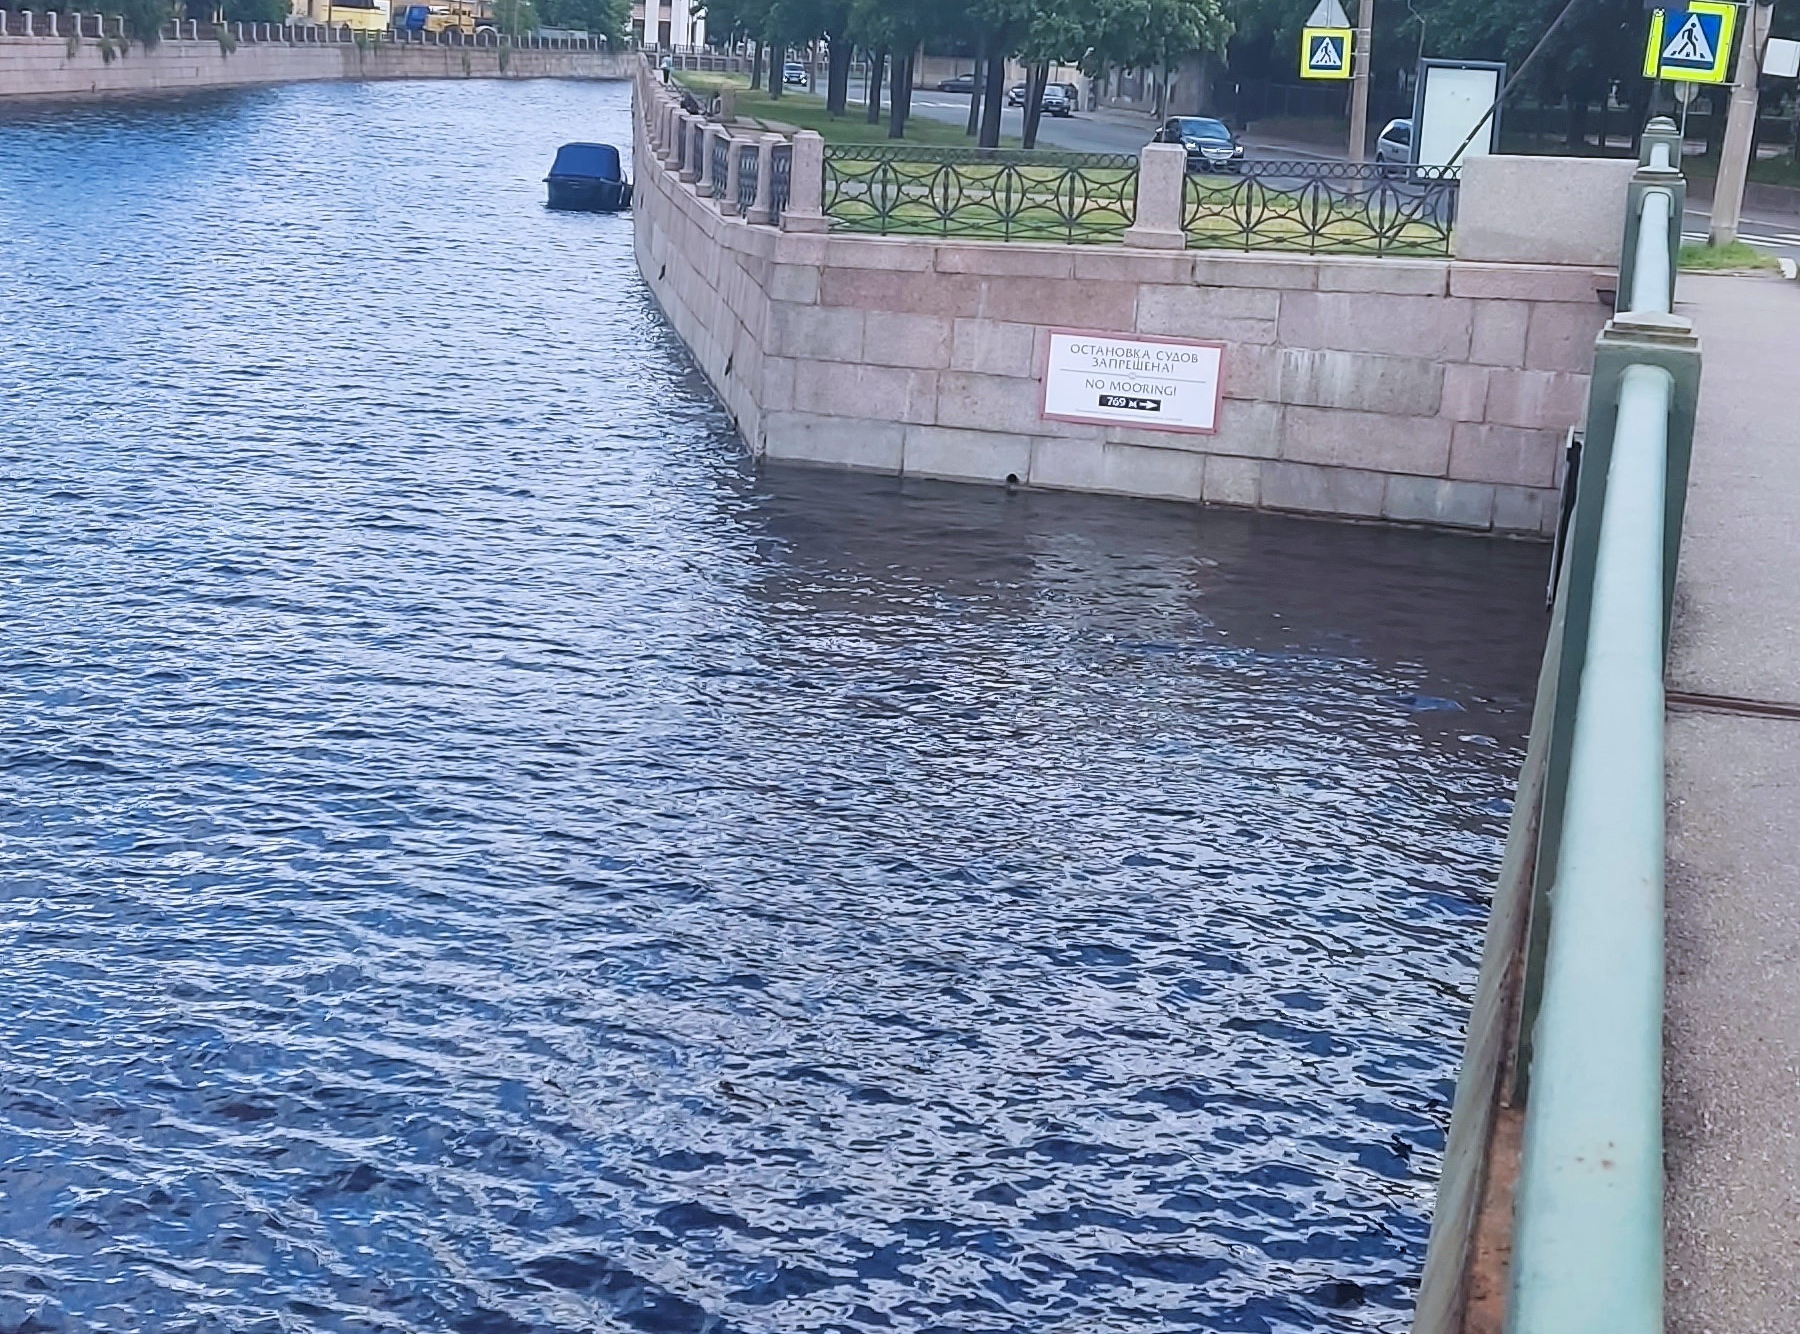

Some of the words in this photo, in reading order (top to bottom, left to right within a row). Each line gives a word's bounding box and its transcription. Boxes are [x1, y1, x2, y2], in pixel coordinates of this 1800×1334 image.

[1070, 344, 1151, 359] ОСТАНОВКА
[1156, 350, 1199, 363] СУДОВ
[1085, 379, 1105, 390] NO
[1109, 381, 1176, 396] MOORING!
[1106, 397, 1126, 406] 769
